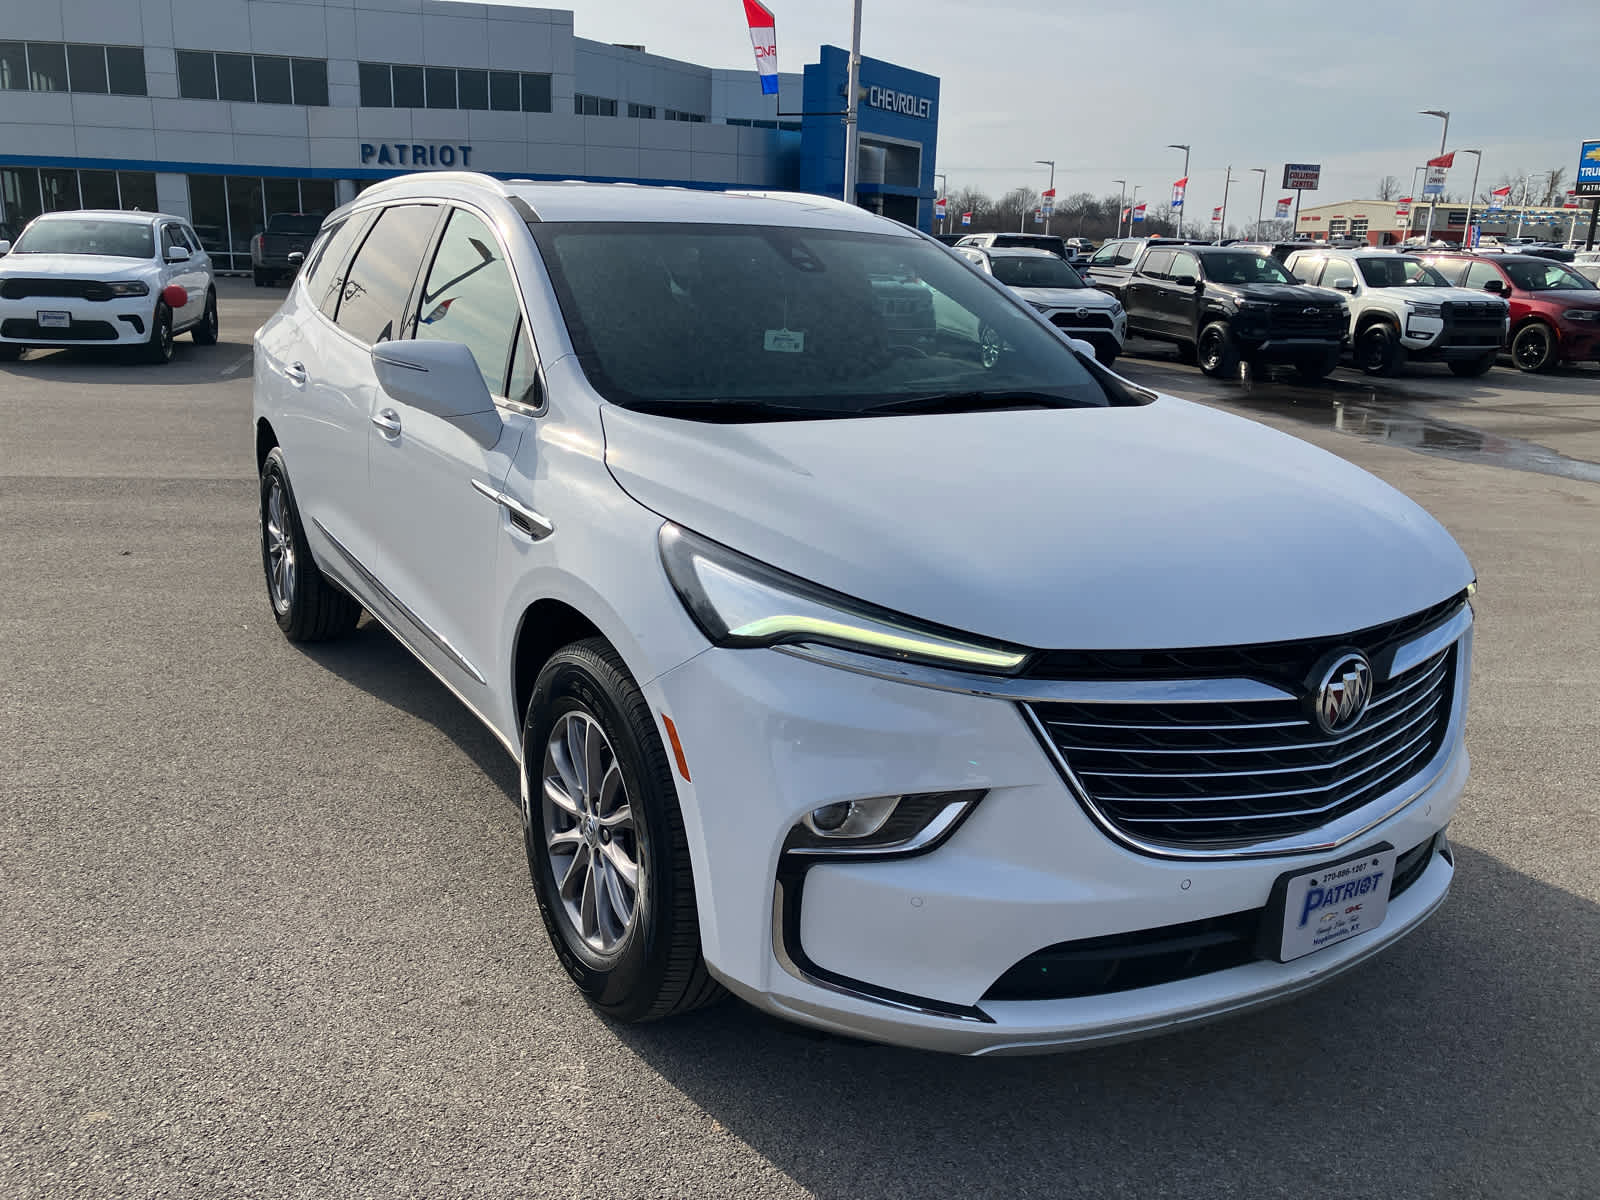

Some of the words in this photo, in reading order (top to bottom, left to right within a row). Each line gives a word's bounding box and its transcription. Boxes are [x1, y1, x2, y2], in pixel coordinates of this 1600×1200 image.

[870, 85, 932, 118] CHEVROLET
[361, 143, 473, 167] PATRIOT
[1299, 873, 1383, 929] PATRIOT
